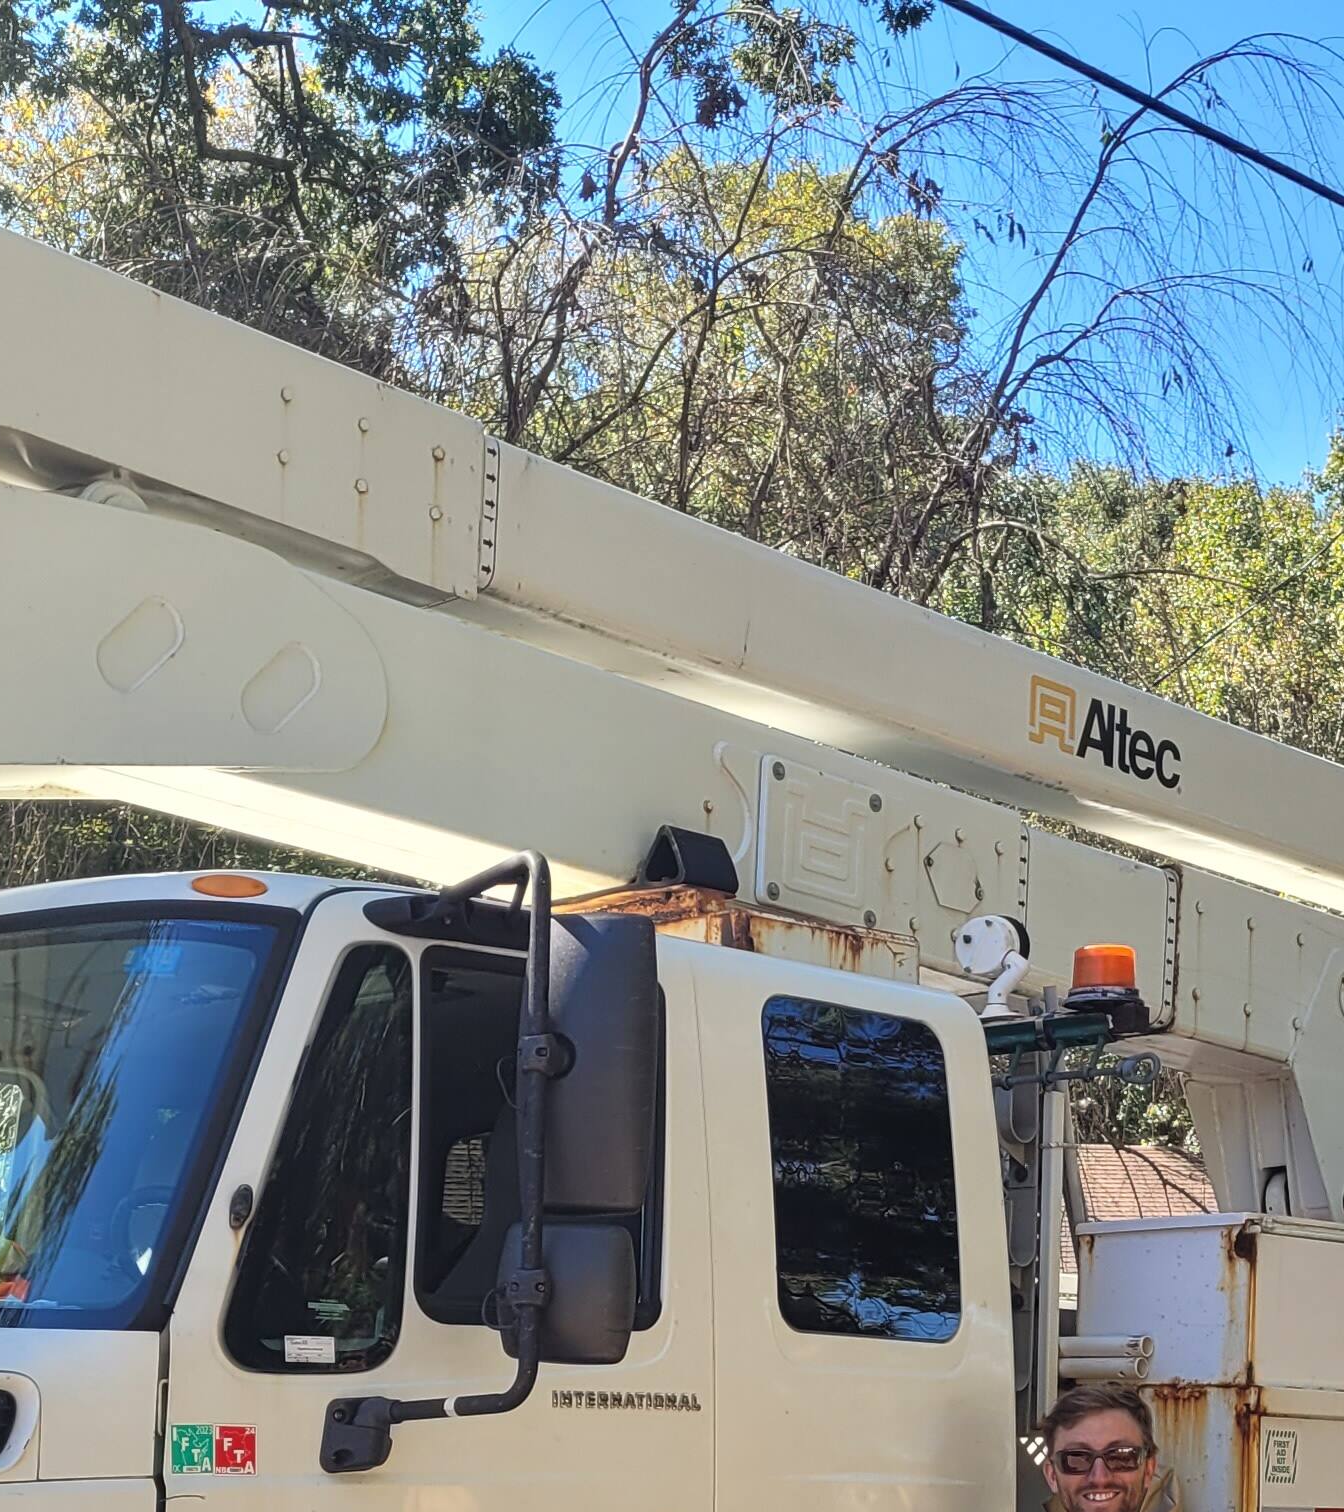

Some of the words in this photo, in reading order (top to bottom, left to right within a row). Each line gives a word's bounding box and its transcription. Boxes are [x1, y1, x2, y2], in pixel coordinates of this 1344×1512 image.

[1075, 697, 1182, 789] Altec
[551, 1390, 702, 1411] INTERNATIONAL
[1272, 1440, 1290, 1449] FIRST
[1276, 1449, 1287, 1457] AID
[1271, 1465, 1291, 1474] INSIDE
